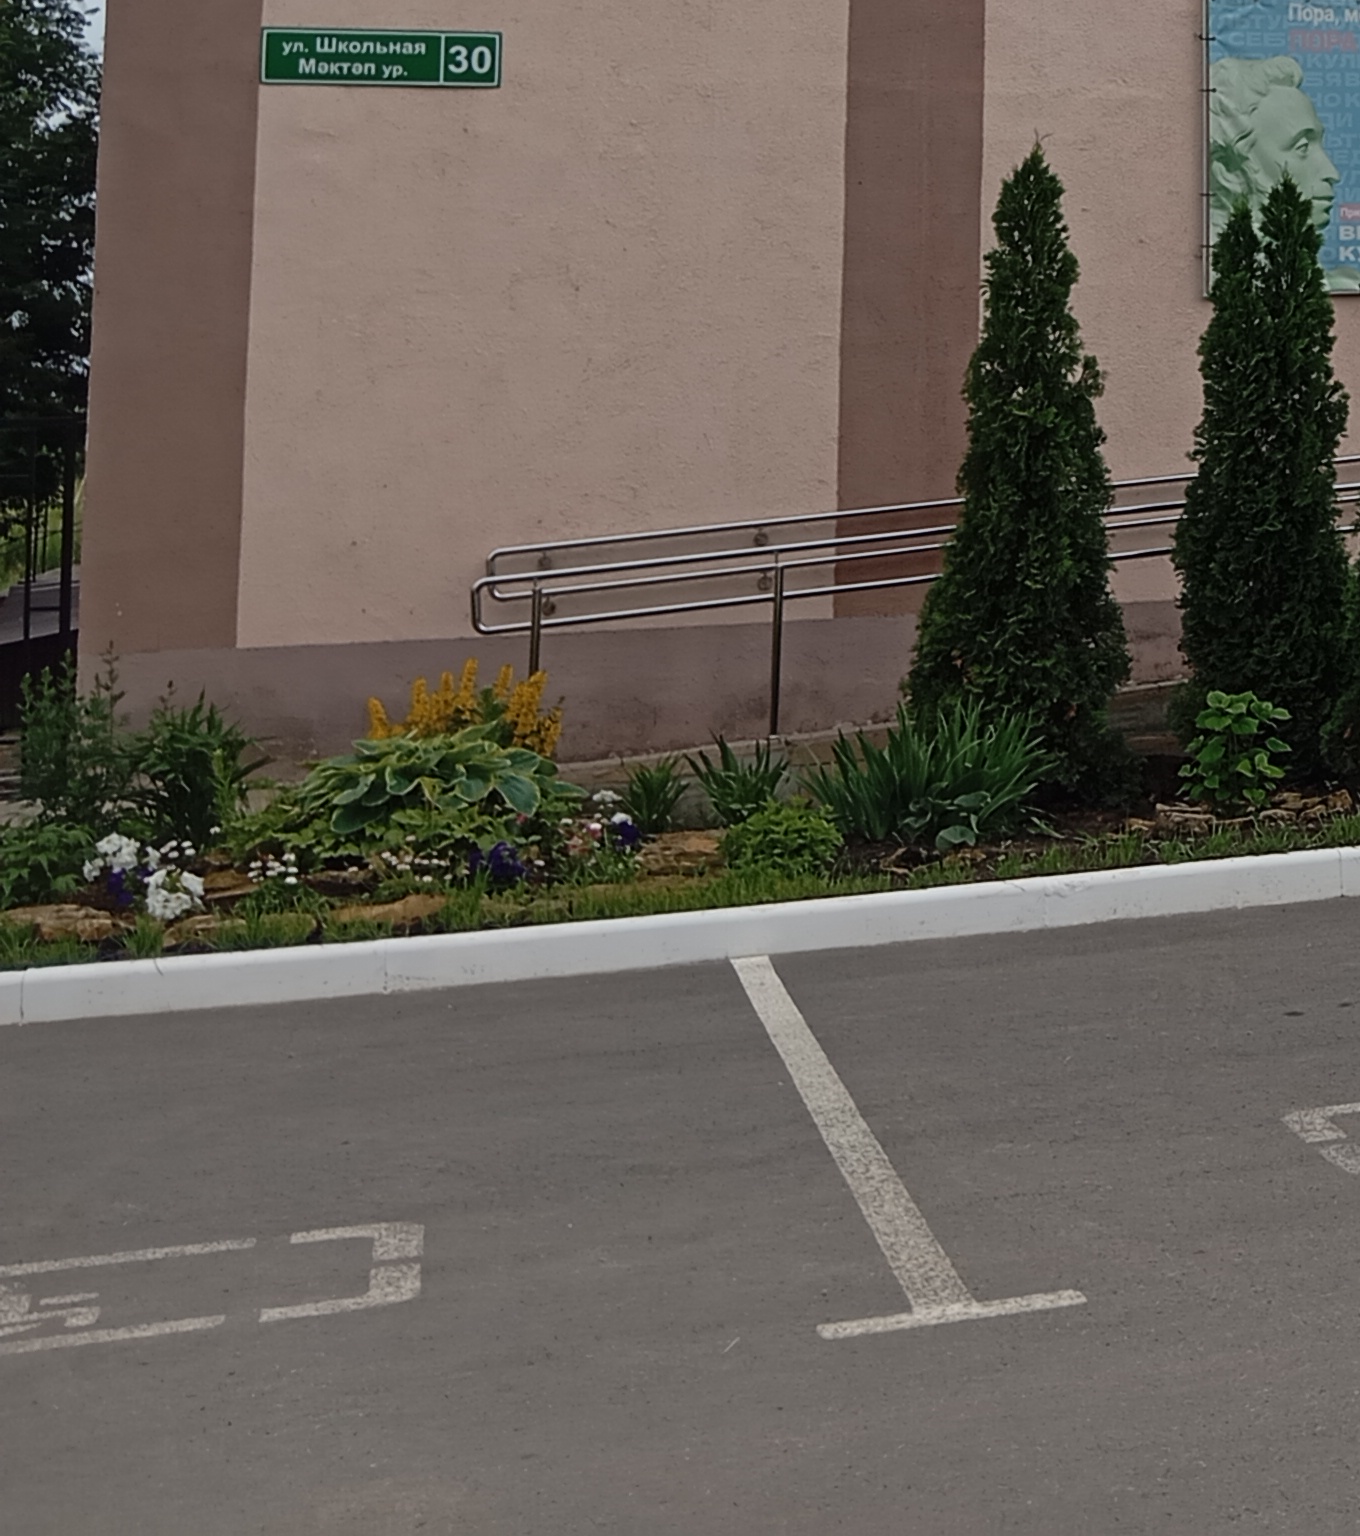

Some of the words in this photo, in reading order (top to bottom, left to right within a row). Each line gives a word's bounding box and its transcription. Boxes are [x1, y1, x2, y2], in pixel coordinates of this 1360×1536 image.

[1288, 3, 1339, 26] Пора,
[282, 41, 309, 55] ул.
[316, 37, 426, 55] Школьная
[1289, 29, 1357, 52] ПОРА
[298, 58, 375, 75] Мәктәп
[382, 64, 408, 77] ур.
[448, 45, 492, 73] 30
